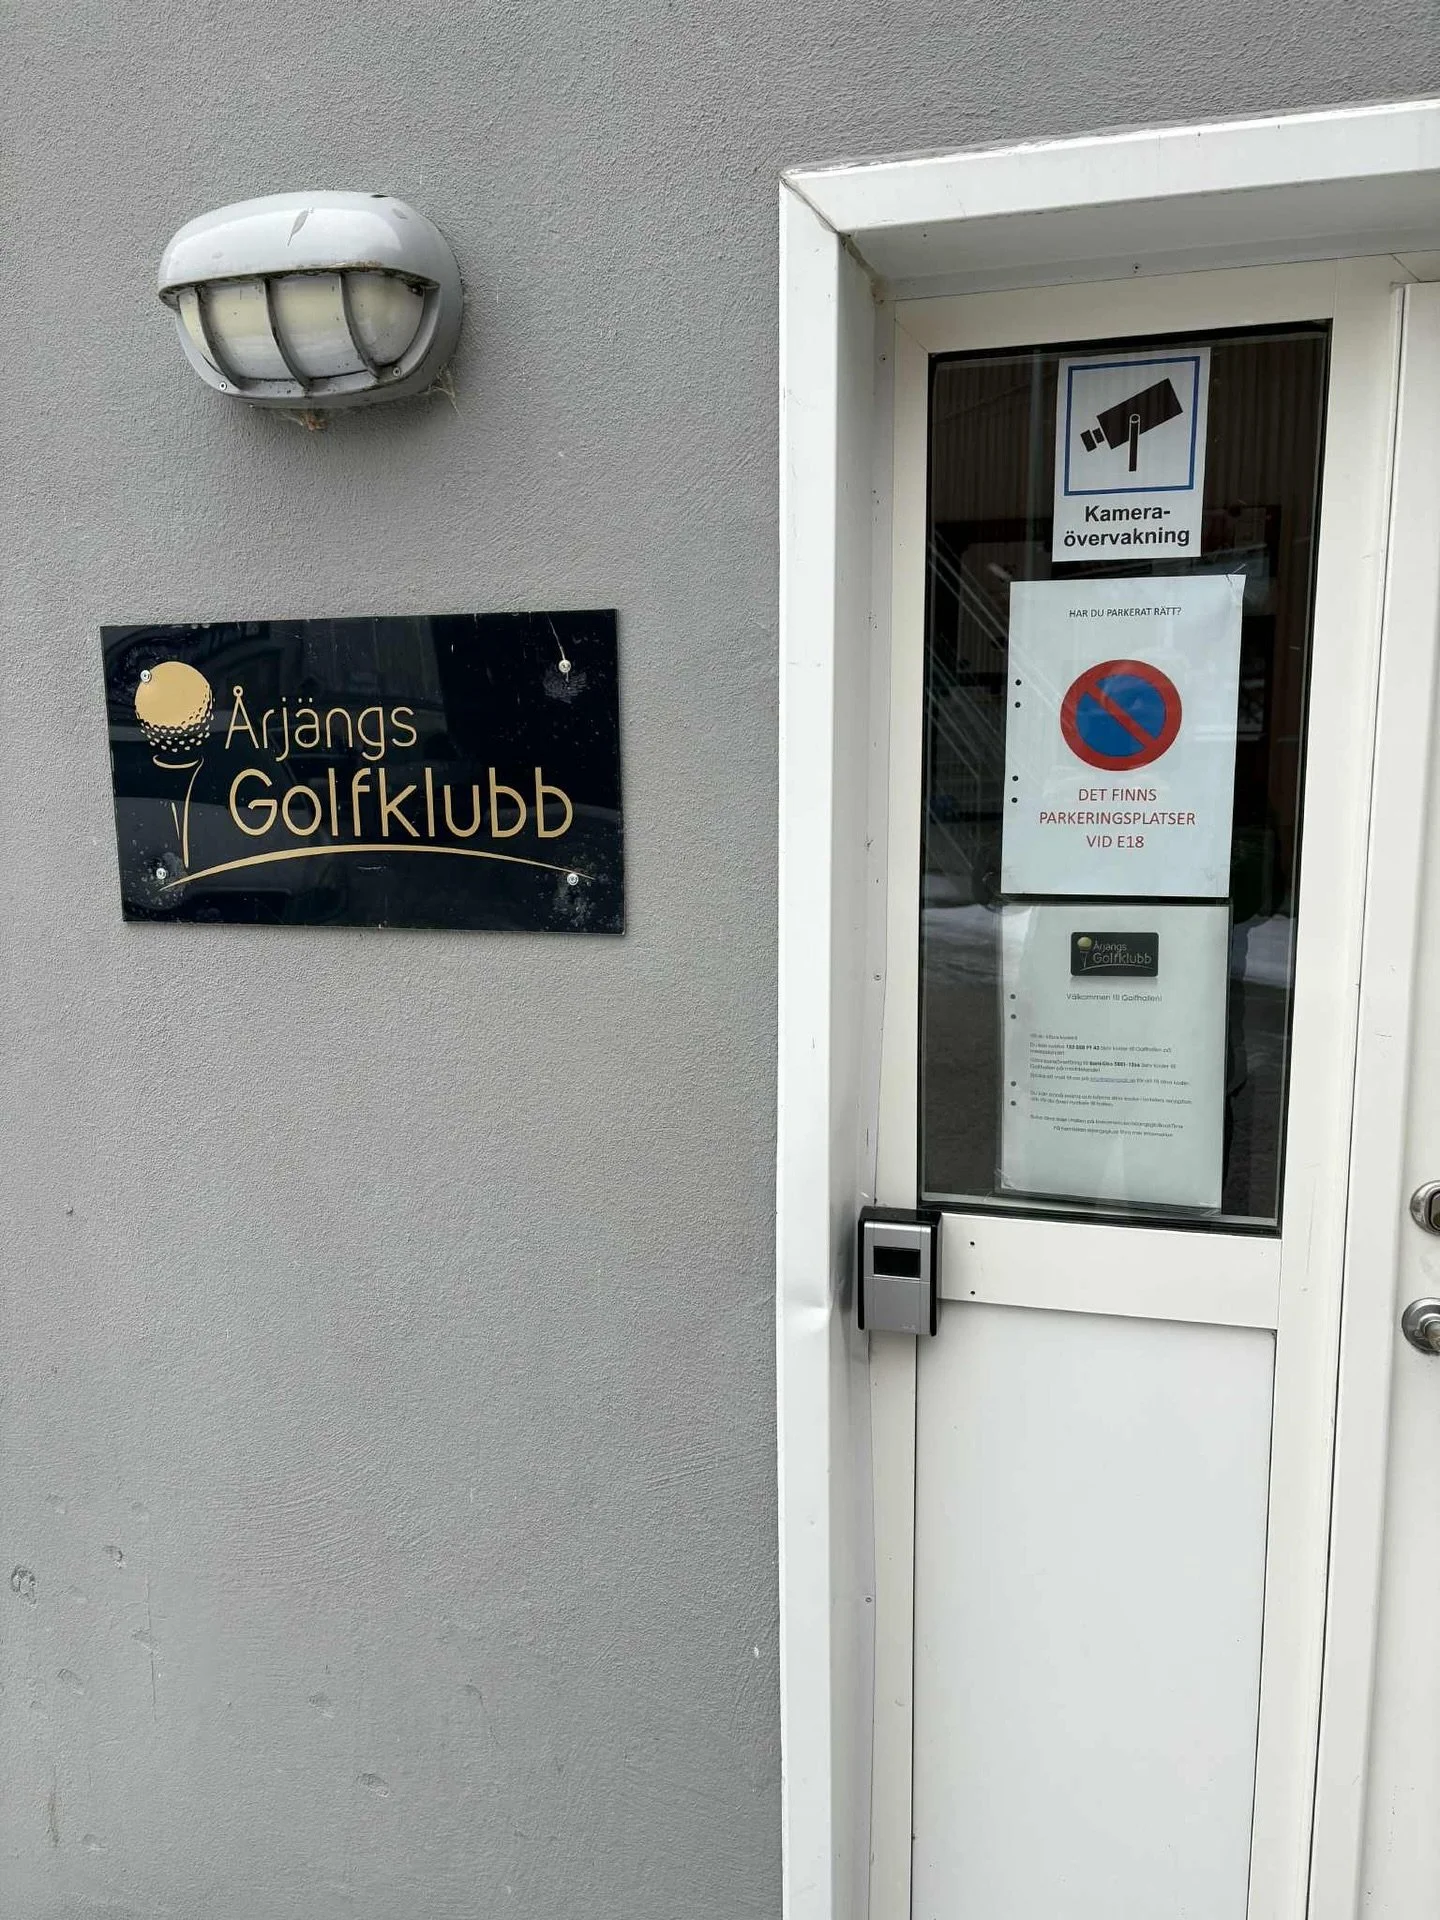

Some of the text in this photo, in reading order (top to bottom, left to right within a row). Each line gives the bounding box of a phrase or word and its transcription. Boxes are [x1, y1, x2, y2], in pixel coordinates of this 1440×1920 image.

[1084, 505, 1171, 523] Kamera-
[1063, 527, 1190, 547] övervakning
[1069, 605, 1182, 618] HAR DU PARKERAT RÄTT?
[225, 685, 417, 761] Årjängs
[229, 766, 574, 839] Golfklubb
[1078, 788, 1158, 802] DET FINNS
[1039, 811, 1196, 826] PARKERINGSPLATSER
[1086, 835, 1145, 849] VID E18
[1092, 951, 1152, 965] Golfklubb
